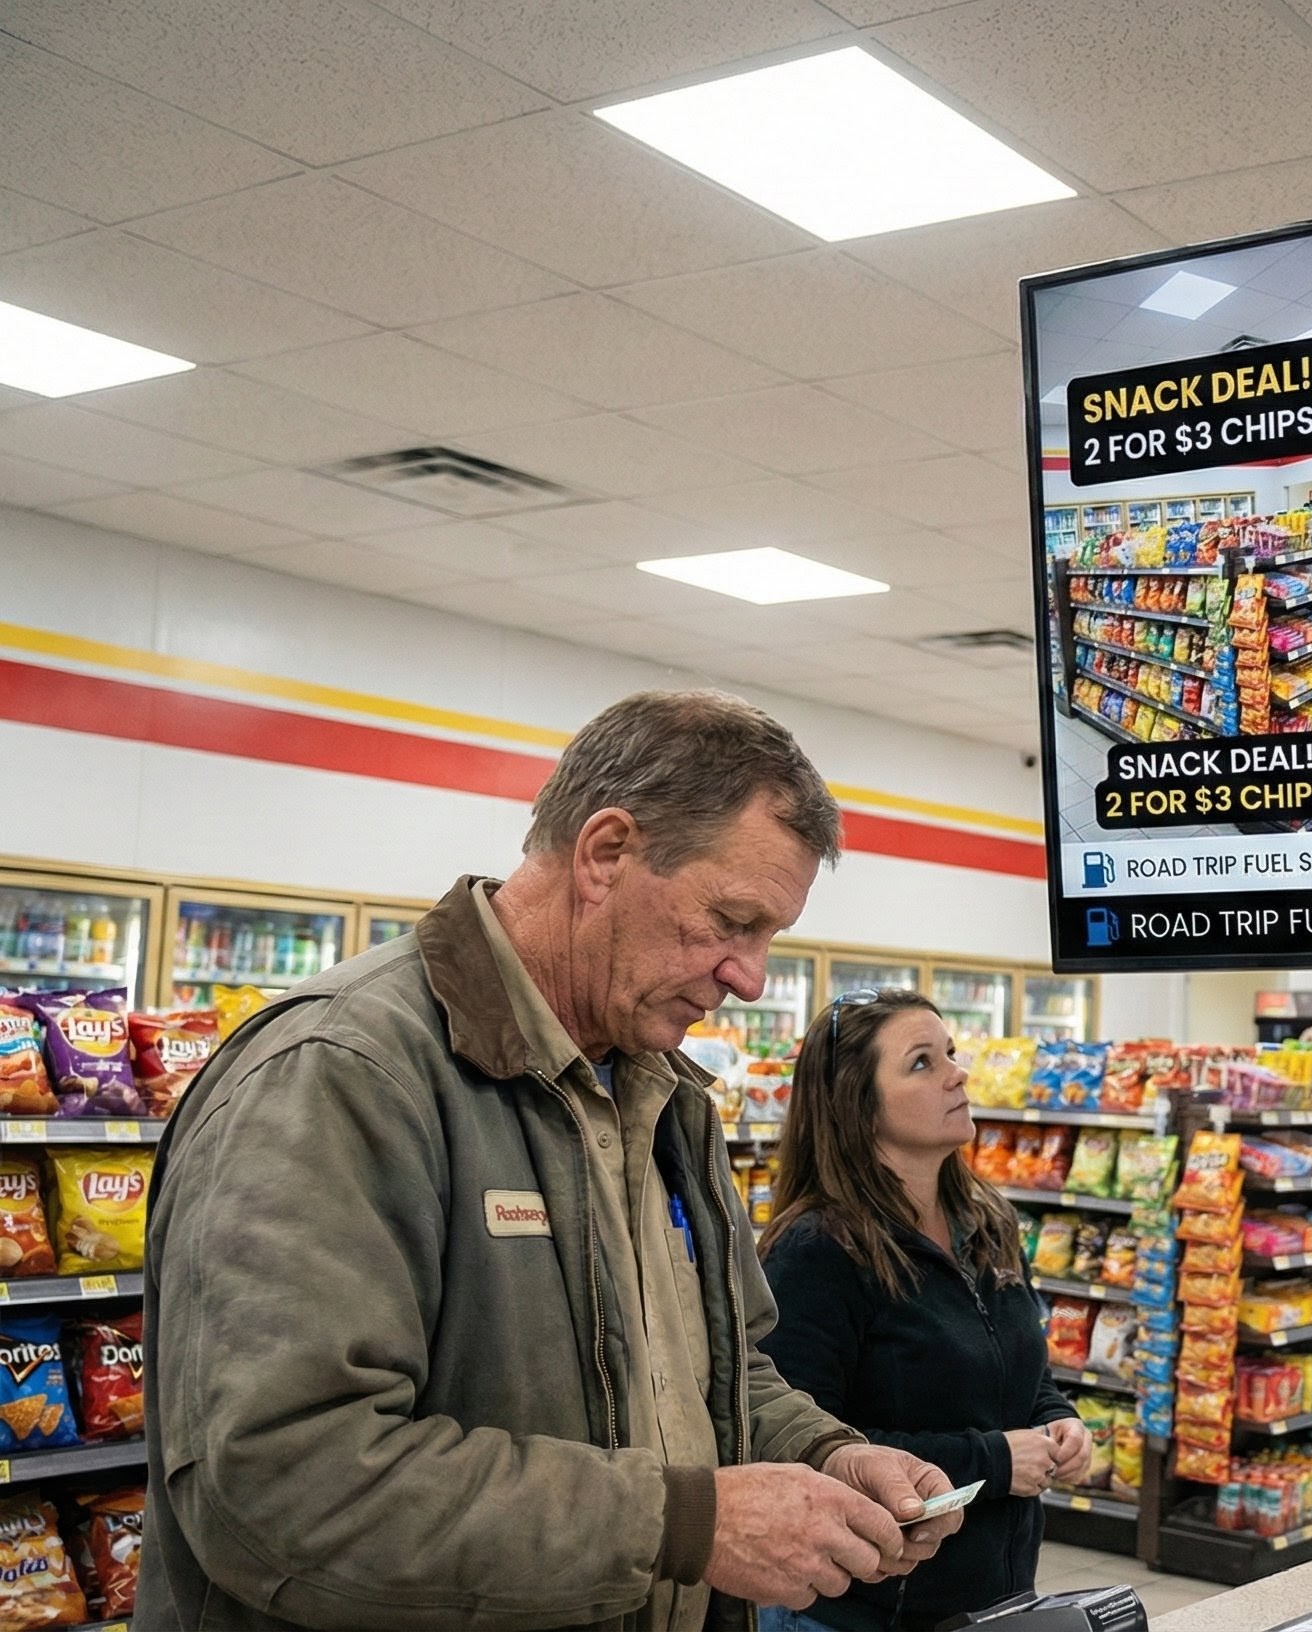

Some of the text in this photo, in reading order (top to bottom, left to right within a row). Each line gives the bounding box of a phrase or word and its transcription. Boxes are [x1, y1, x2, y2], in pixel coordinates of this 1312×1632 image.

[1083, 357, 1311, 423] SNACK DEAL!
[1084, 440, 1100, 466] 2
[1109, 430, 1166, 462] FOR
[1176, 422, 1212, 456] $3
[1119, 751, 1222, 779] SNACK
[1106, 792, 1123, 817] 2
[1131, 790, 1187, 815] FOR
[1195, 785, 1231, 814] $3
[1128, 857, 1186, 878] ROAD
[1194, 856, 1236, 875] TRIP
[1245, 854, 1293, 873] FUEL
[1132, 913, 1210, 938] ROAD
[1219, 910, 1278, 936] TRIP
